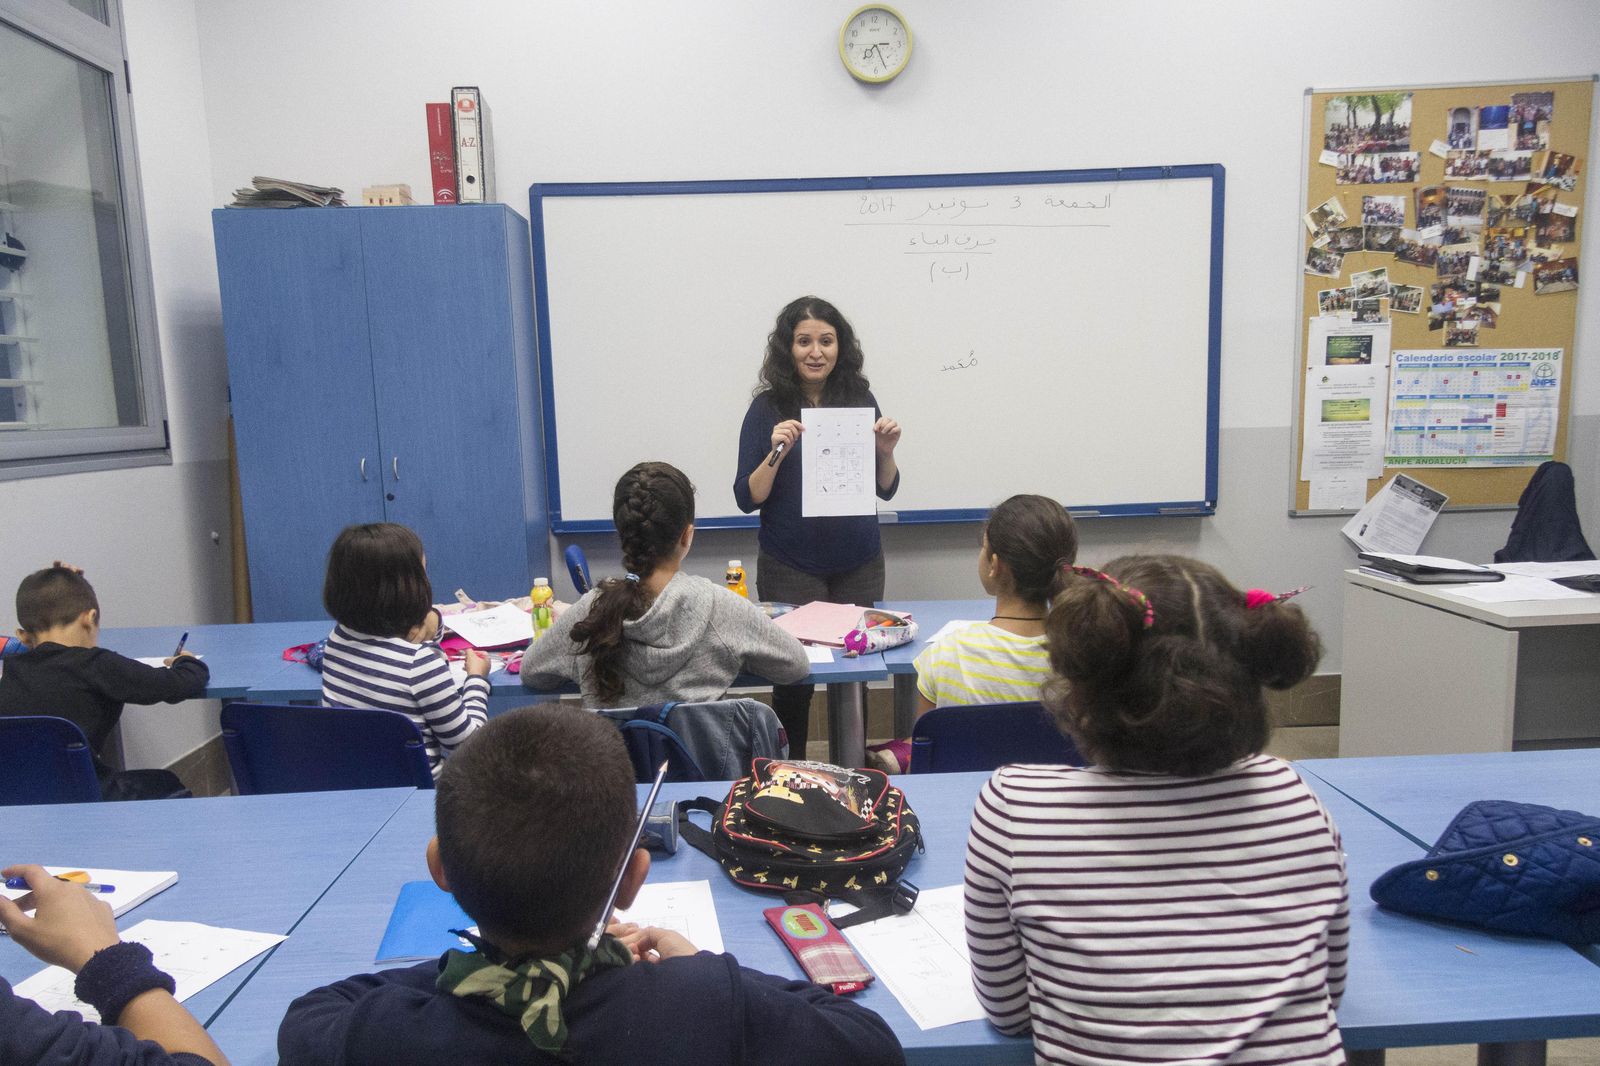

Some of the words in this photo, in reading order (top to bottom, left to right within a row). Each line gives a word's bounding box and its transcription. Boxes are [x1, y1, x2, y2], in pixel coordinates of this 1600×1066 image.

[871, 15, 879, 24] 12
[851, 29, 858, 38] 10
[873, 66, 879, 74] 6
[859, 194, 896, 214] 2017
[1010, 195, 1022, 209] 3
[1396, 353, 1453, 362] Calendario
[1457, 353, 1497, 362] escolar
[1500, 351, 1559, 361] 2017-2018
[1530, 378, 1557, 388] ANPE
[1388, 457, 1414, 465] ANPE
